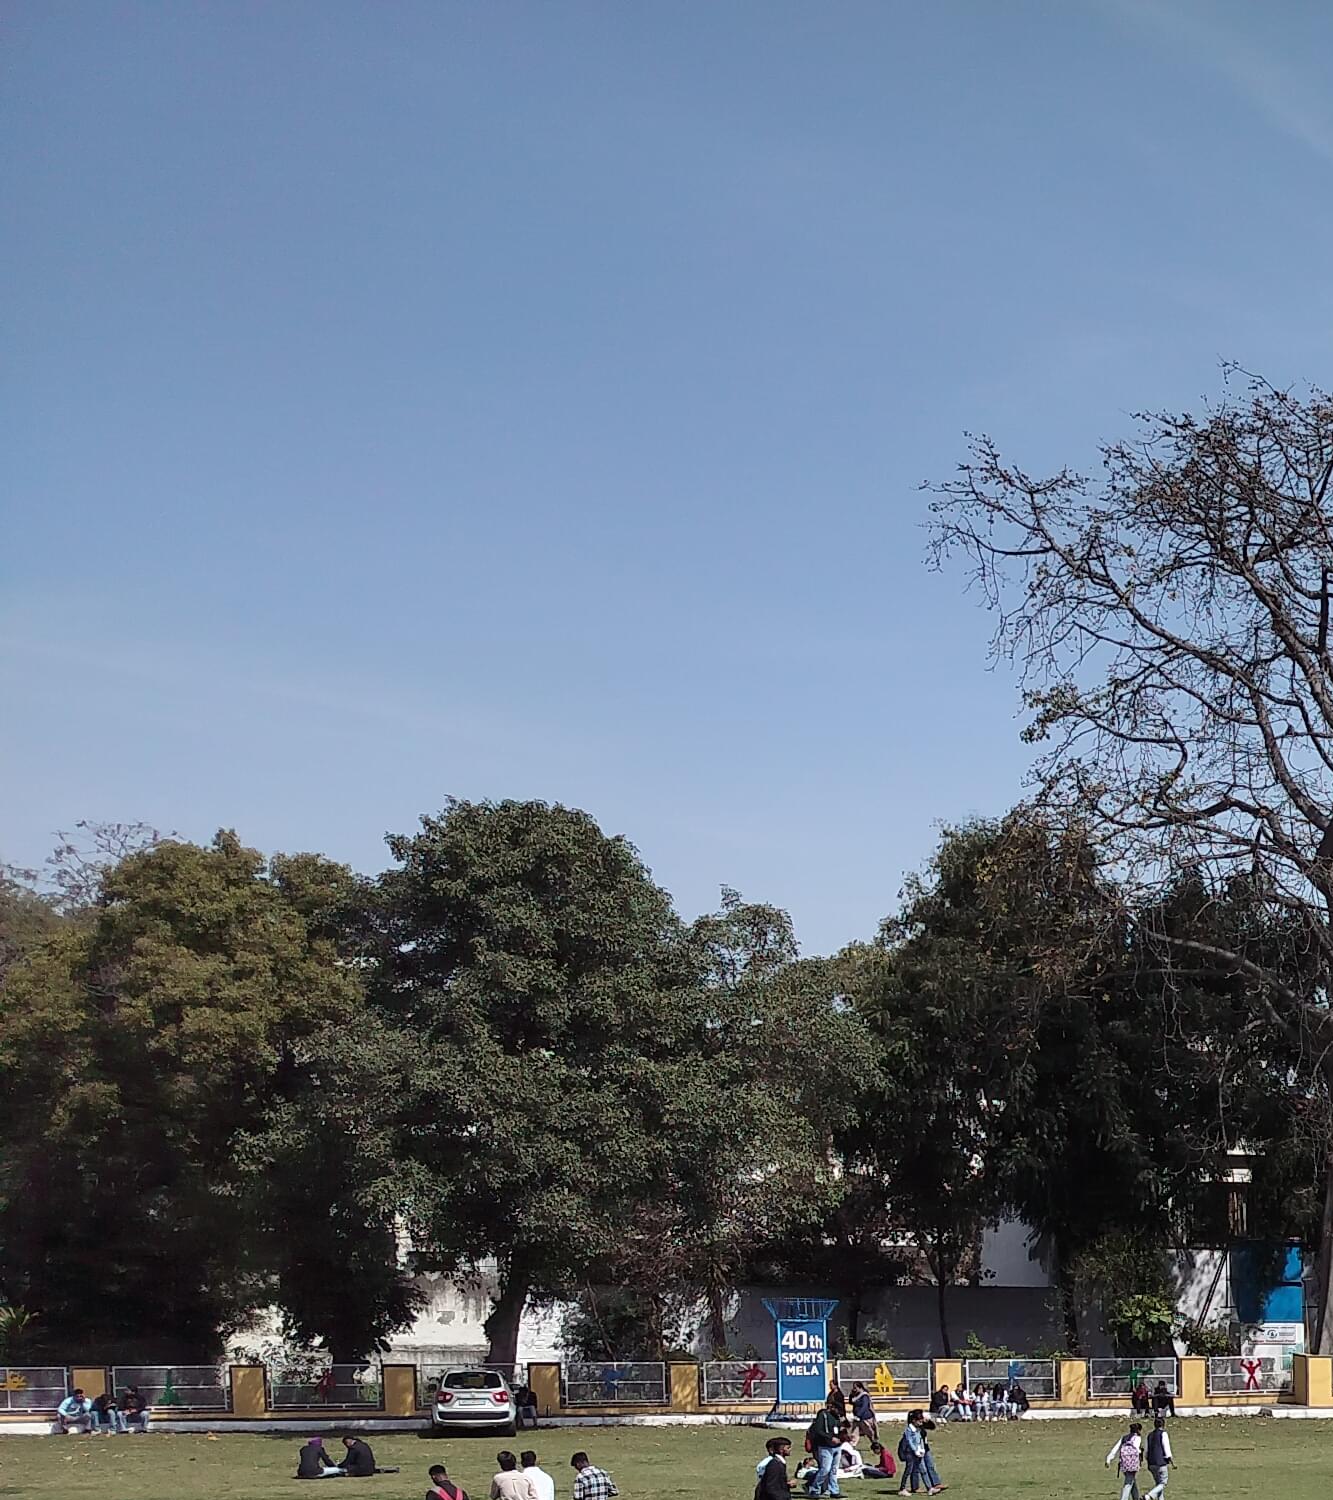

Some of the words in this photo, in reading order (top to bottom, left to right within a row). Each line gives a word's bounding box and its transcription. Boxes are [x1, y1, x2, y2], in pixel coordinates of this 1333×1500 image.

[781, 1330, 823, 1350] 40th
[781, 1351, 825, 1363] SPORTS
[785, 1365, 820, 1376] MELA
